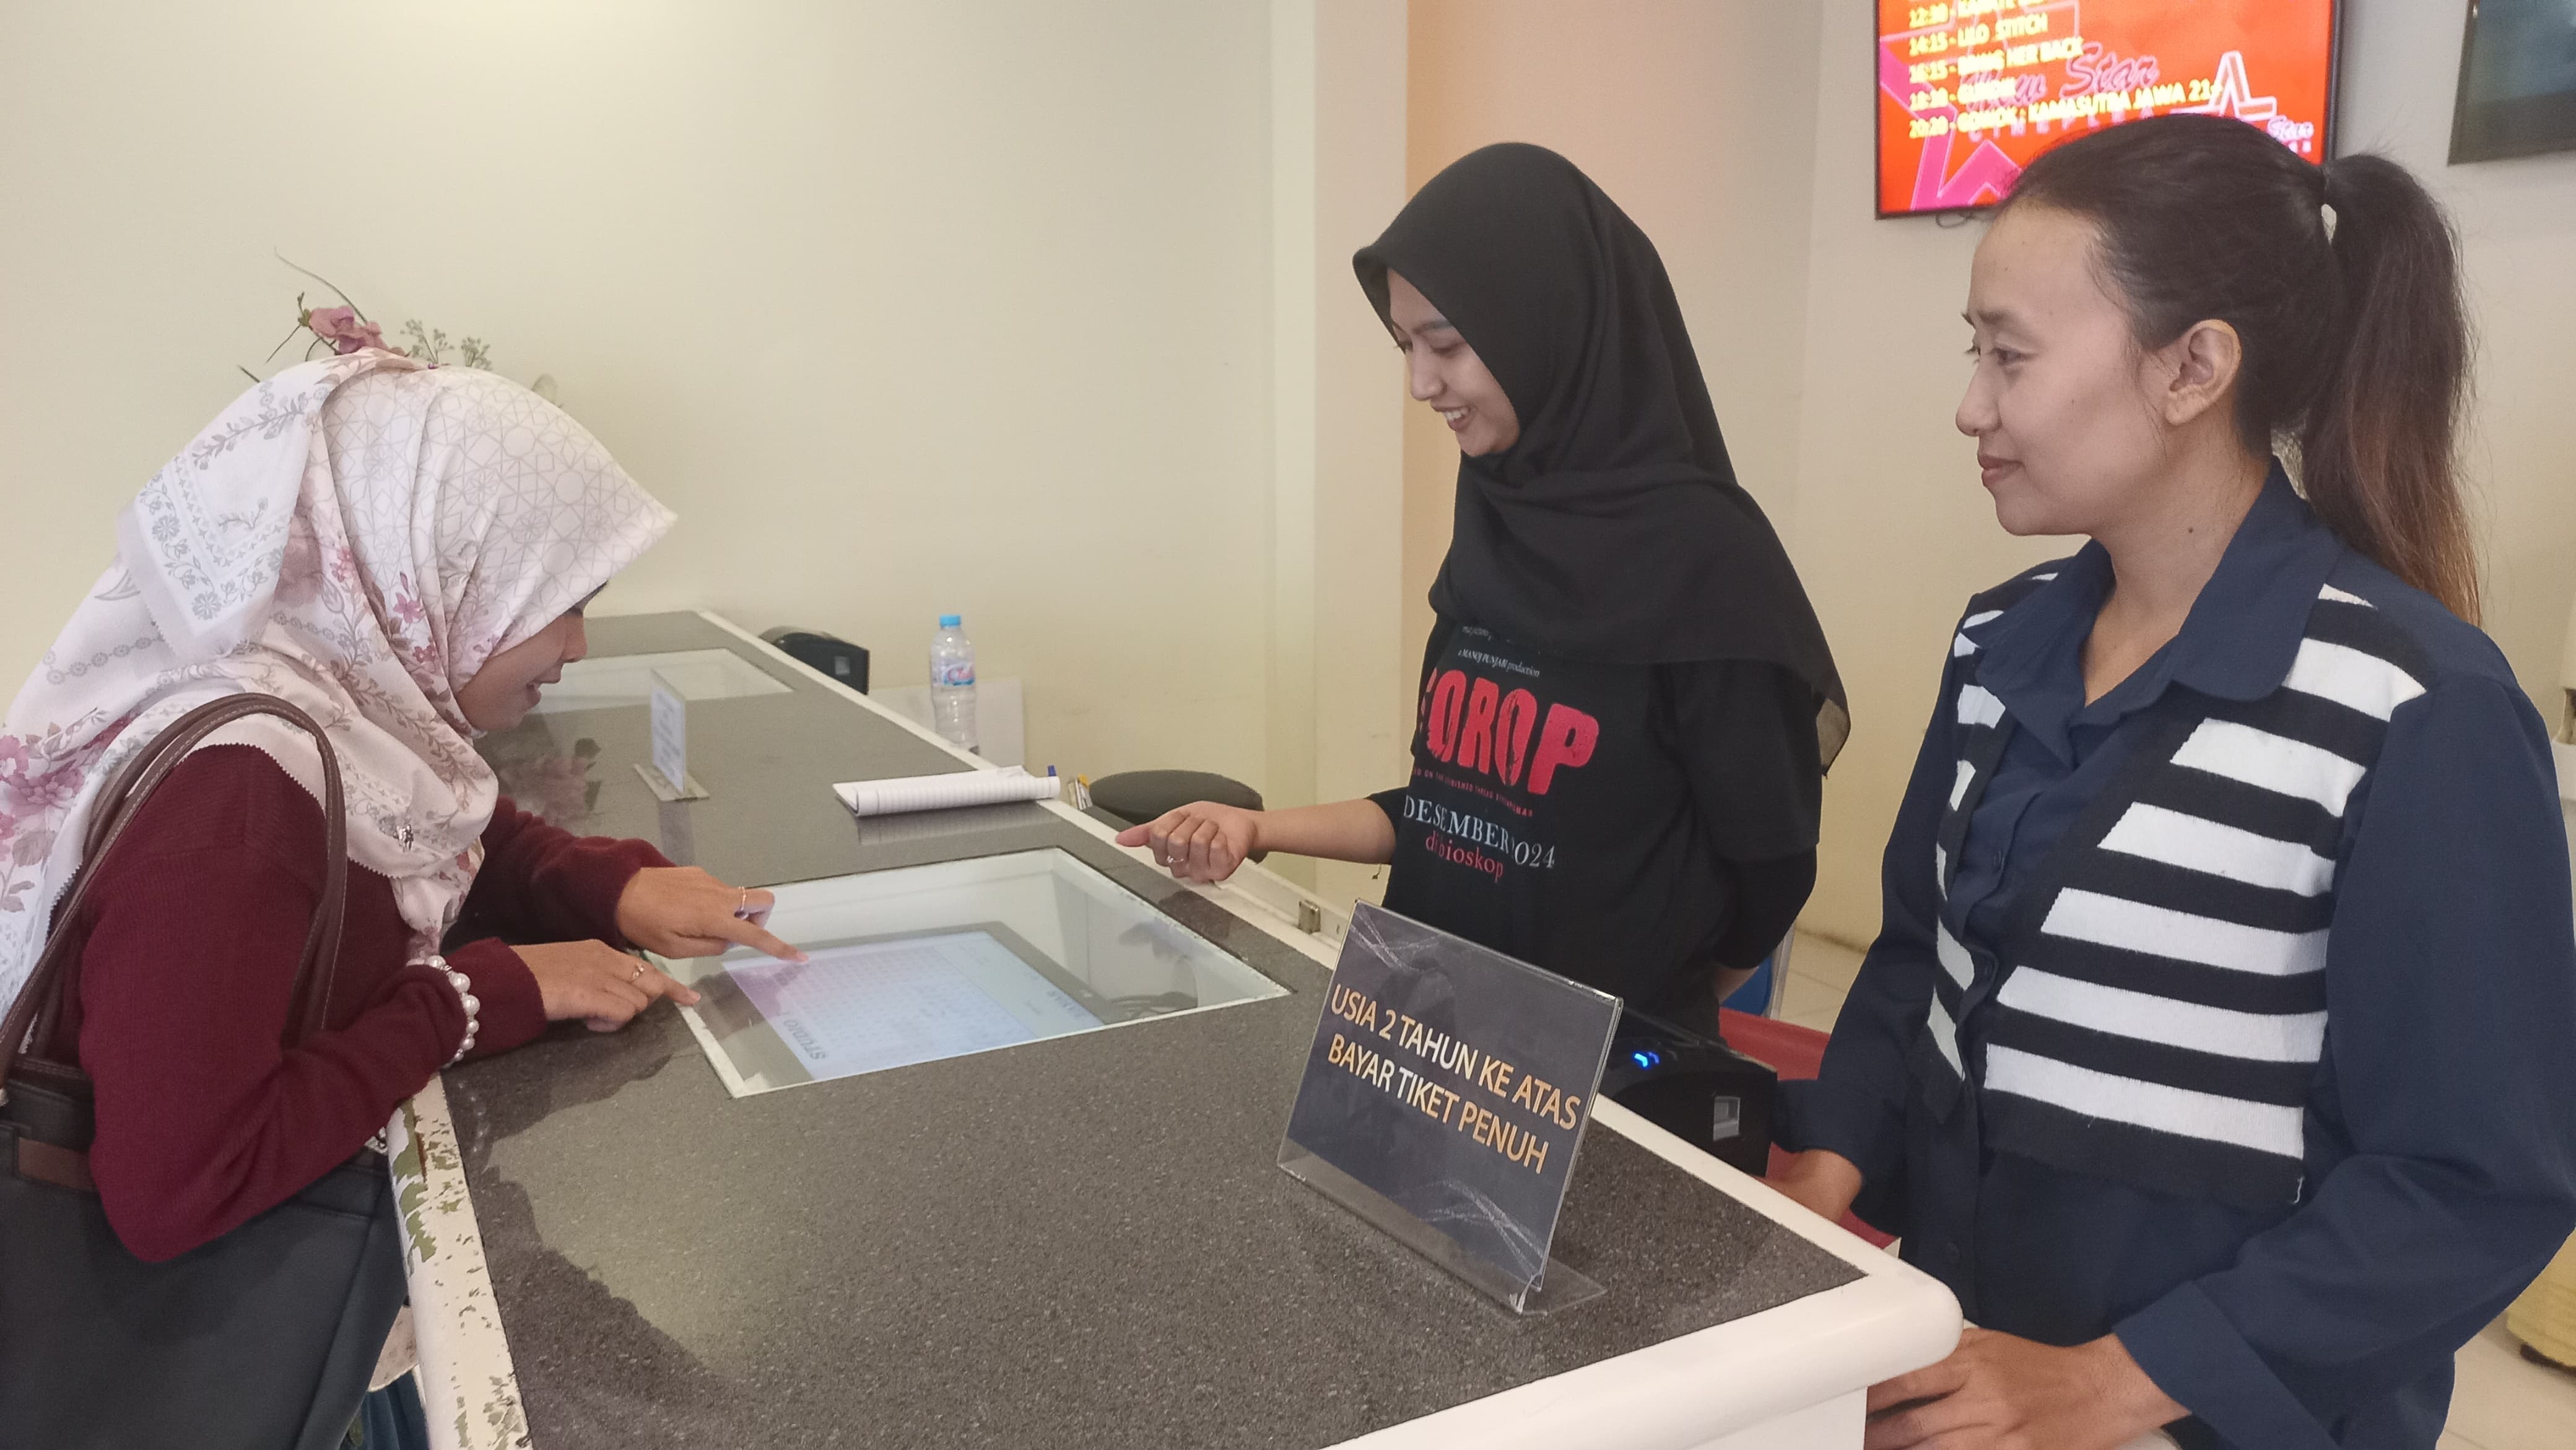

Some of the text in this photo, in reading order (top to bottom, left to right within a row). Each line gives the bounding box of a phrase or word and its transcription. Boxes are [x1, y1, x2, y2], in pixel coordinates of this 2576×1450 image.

[1995, 12, 2048, 41] STITCH
[2040, 35, 2084, 63] BACK
[2059, 41, 2160, 99] Star
[2133, 82, 2187, 110] JAWA
[1420, 666, 1599, 796] OROP
[1404, 795, 1556, 869] DESEMBER 024
[1331, 983, 1582, 1131] USIA 2 TAHUN KE ATAS
[1328, 1033, 1549, 1174] BAYAR TIKET PENUH
